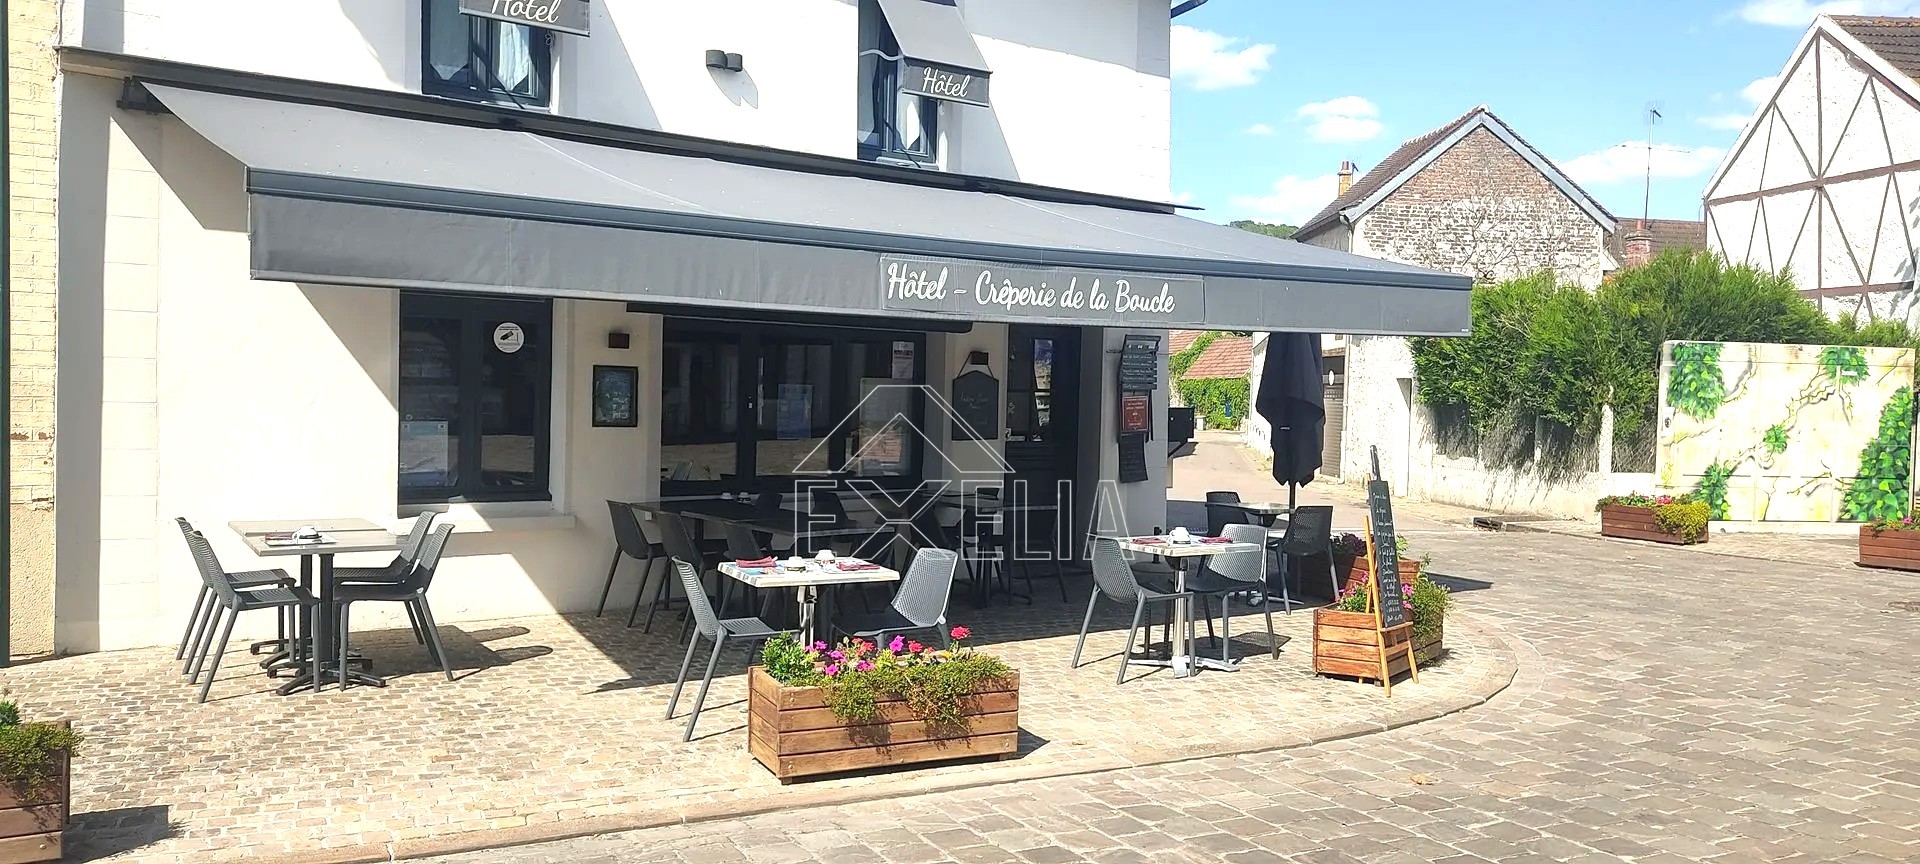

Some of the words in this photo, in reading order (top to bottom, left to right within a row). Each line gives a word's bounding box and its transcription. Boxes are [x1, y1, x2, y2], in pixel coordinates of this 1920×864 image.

[922, 66, 971, 98] Hôtel
[887, 262, 948, 301] Hôtel
[975, 269, 1057, 312] Crêperie
[1060, 276, 1085, 310] de
[1089, 278, 1110, 311] la
[1114, 279, 1176, 314] Boucle
